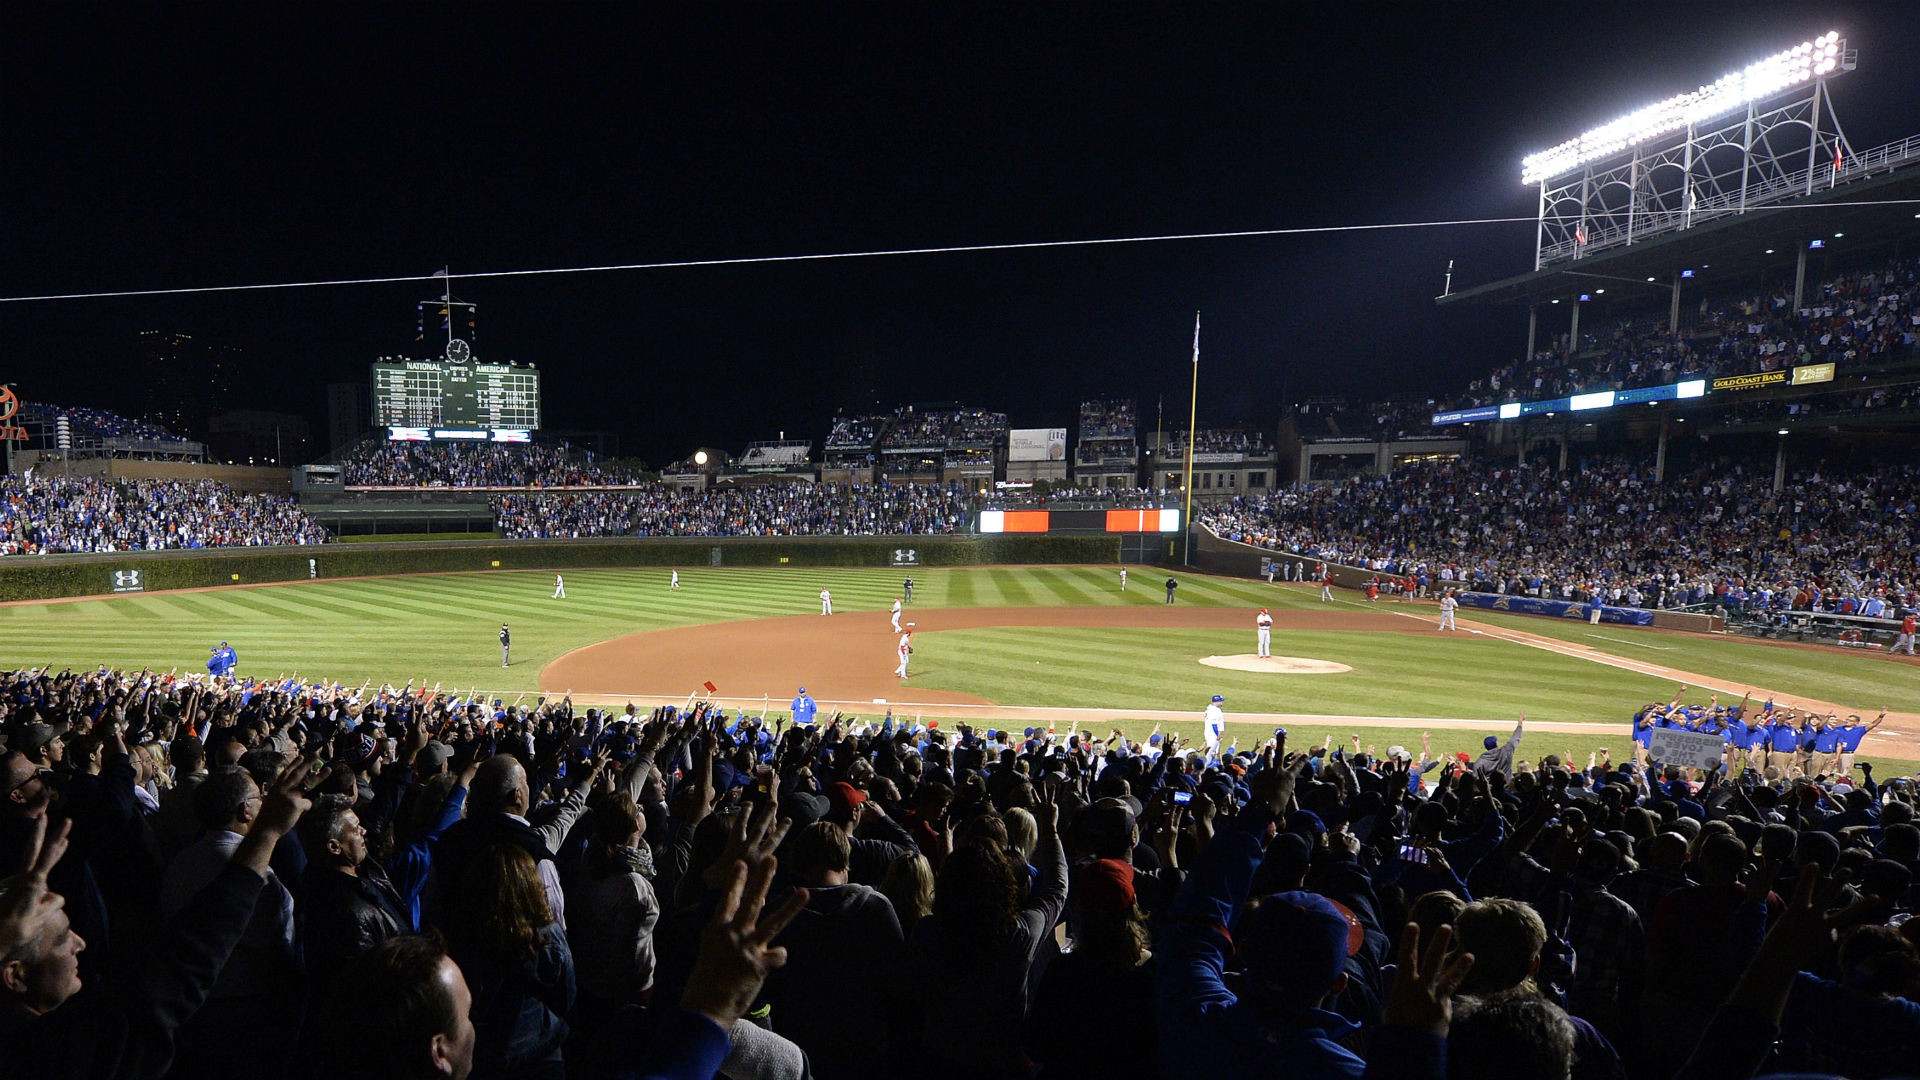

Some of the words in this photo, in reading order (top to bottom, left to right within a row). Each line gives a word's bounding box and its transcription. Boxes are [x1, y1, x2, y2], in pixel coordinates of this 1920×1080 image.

[406, 362, 442, 370] NATIONAL
[476, 365, 510, 374] AMERICAN
[1713, 379, 1735, 388] GOLD
[1735, 376, 1761, 386] COAST
[1762, 373, 1785, 382] BANK
